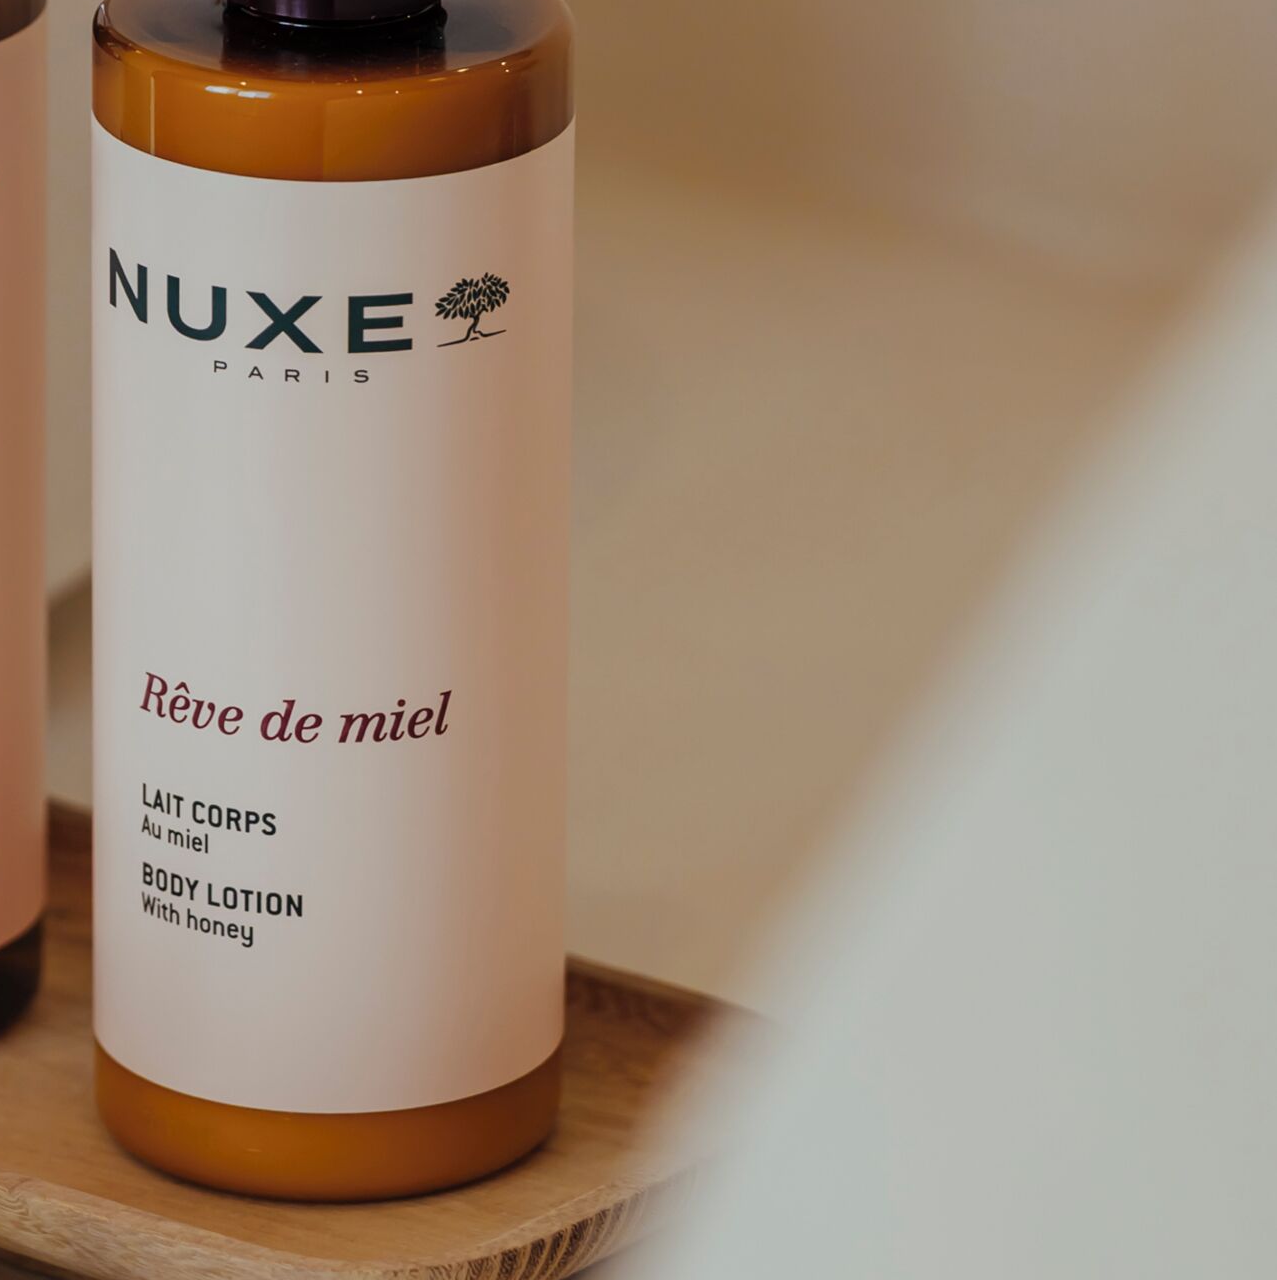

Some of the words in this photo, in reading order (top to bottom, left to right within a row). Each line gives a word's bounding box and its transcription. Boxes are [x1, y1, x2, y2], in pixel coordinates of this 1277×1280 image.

[109, 247, 413, 354] NUXE
[213, 360, 369, 383] PARIS
[139, 671, 244, 736] Rêve
[260, 699, 323, 744] de
[338, 690, 452, 744] miel
[141, 814, 161, 840] Au
[168, 829, 209, 854] miel
[142, 783, 184, 818] LAIT
[192, 801, 277, 836] CORPS
[142, 862, 199, 901] BODY
[208, 883, 303, 918] LOTION
[141, 891, 180, 926] With
[187, 908, 254, 948] honey
